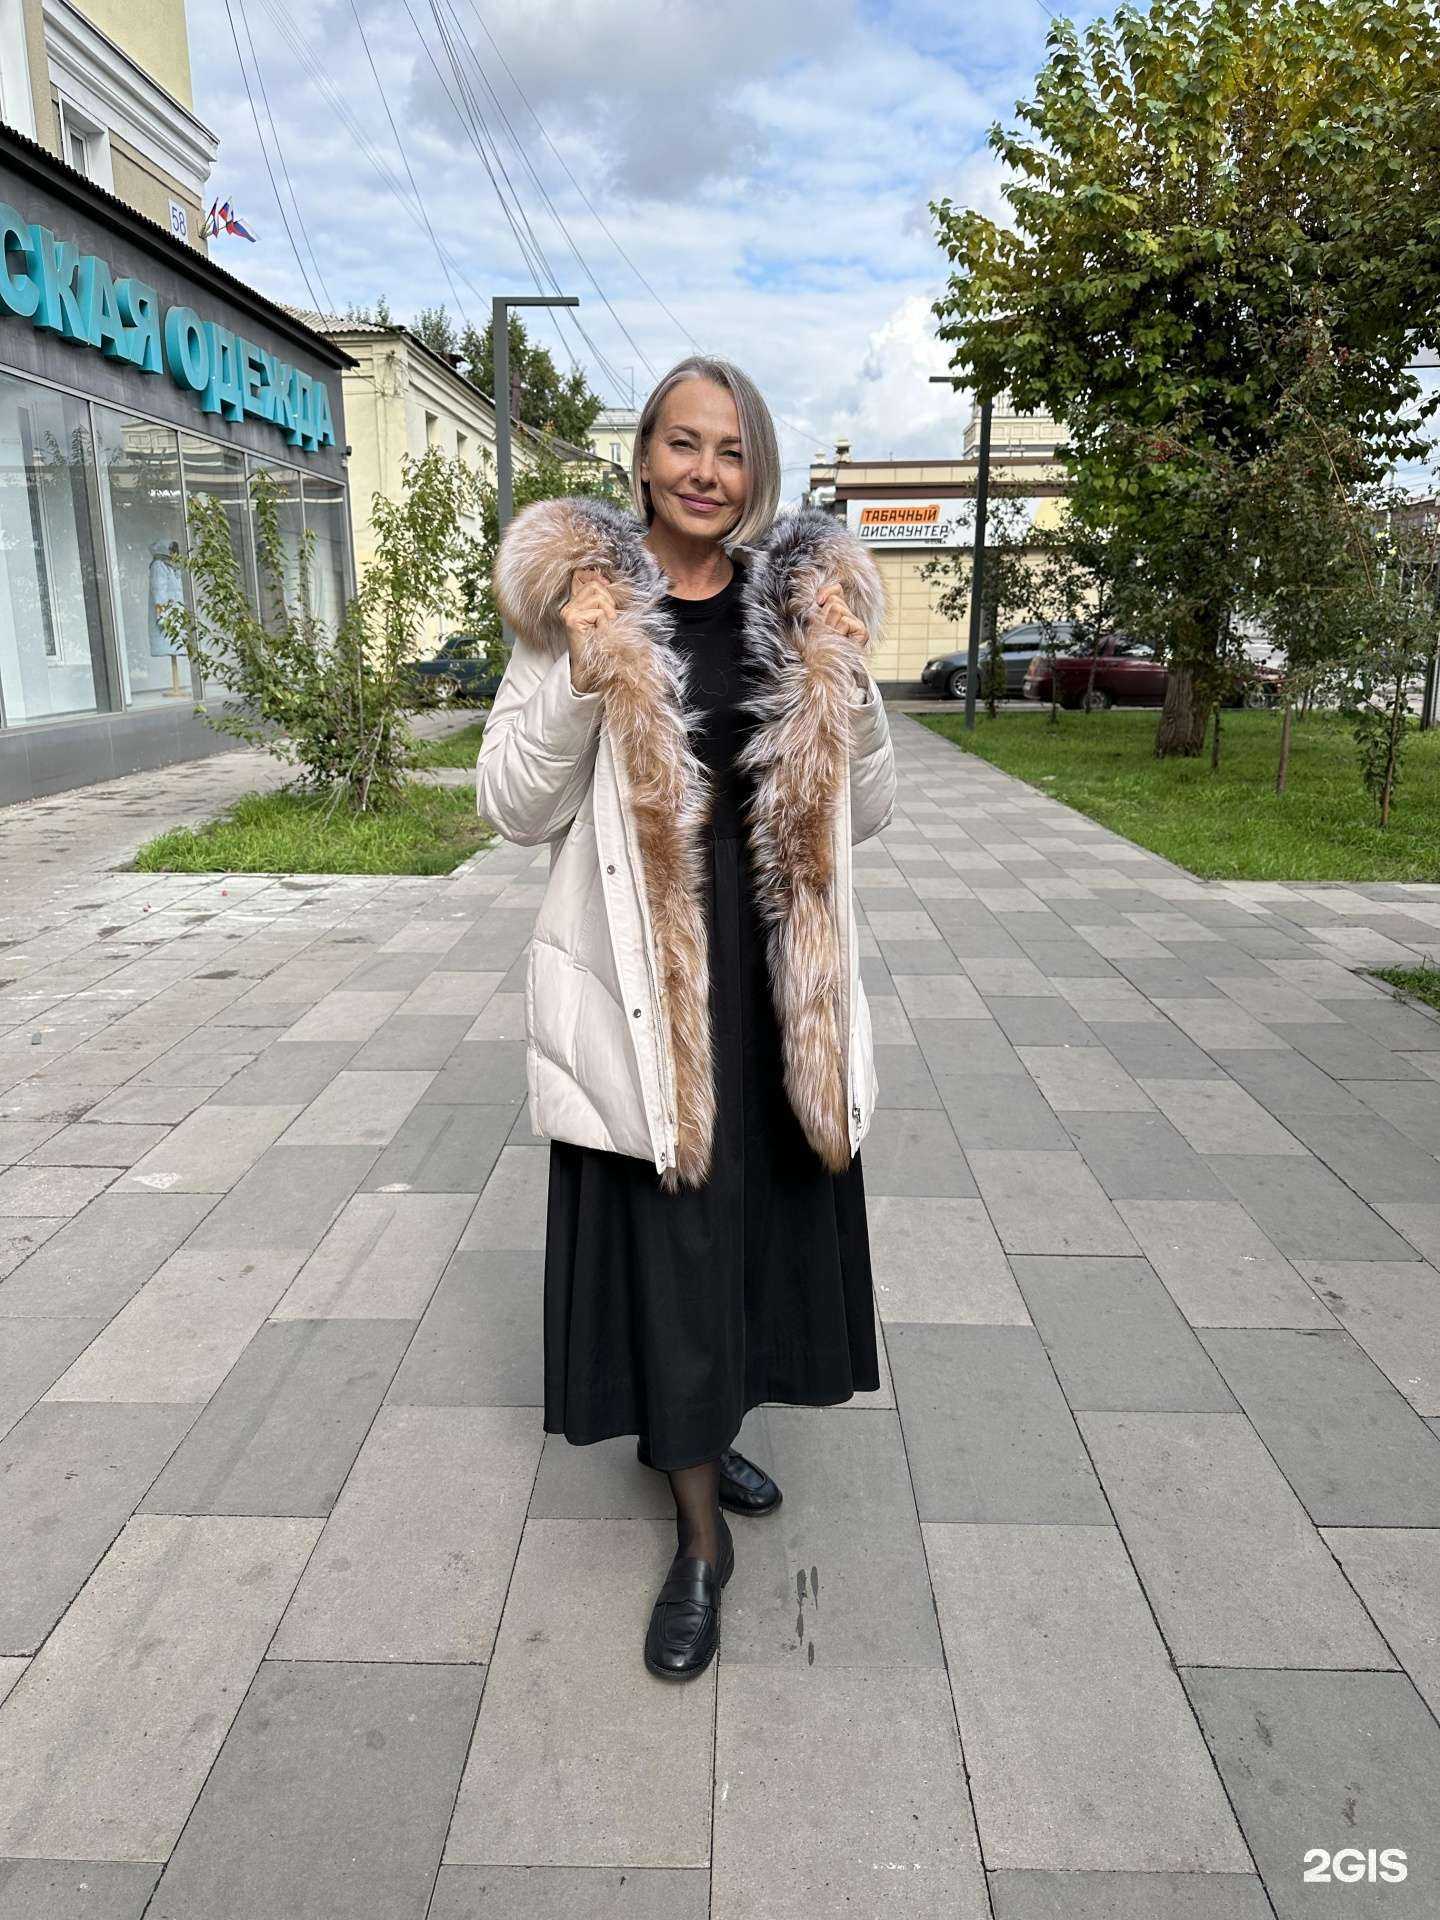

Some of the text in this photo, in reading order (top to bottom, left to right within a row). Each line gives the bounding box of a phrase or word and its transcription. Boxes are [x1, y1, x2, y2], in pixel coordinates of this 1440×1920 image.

[171, 206, 187, 236] 58
[165, 306, 336, 452] ОДЕЖДА
[864, 506, 937, 522] ТАБАЧНЫЙ
[860, 524, 949, 537] ДИСКАУНТЕР
